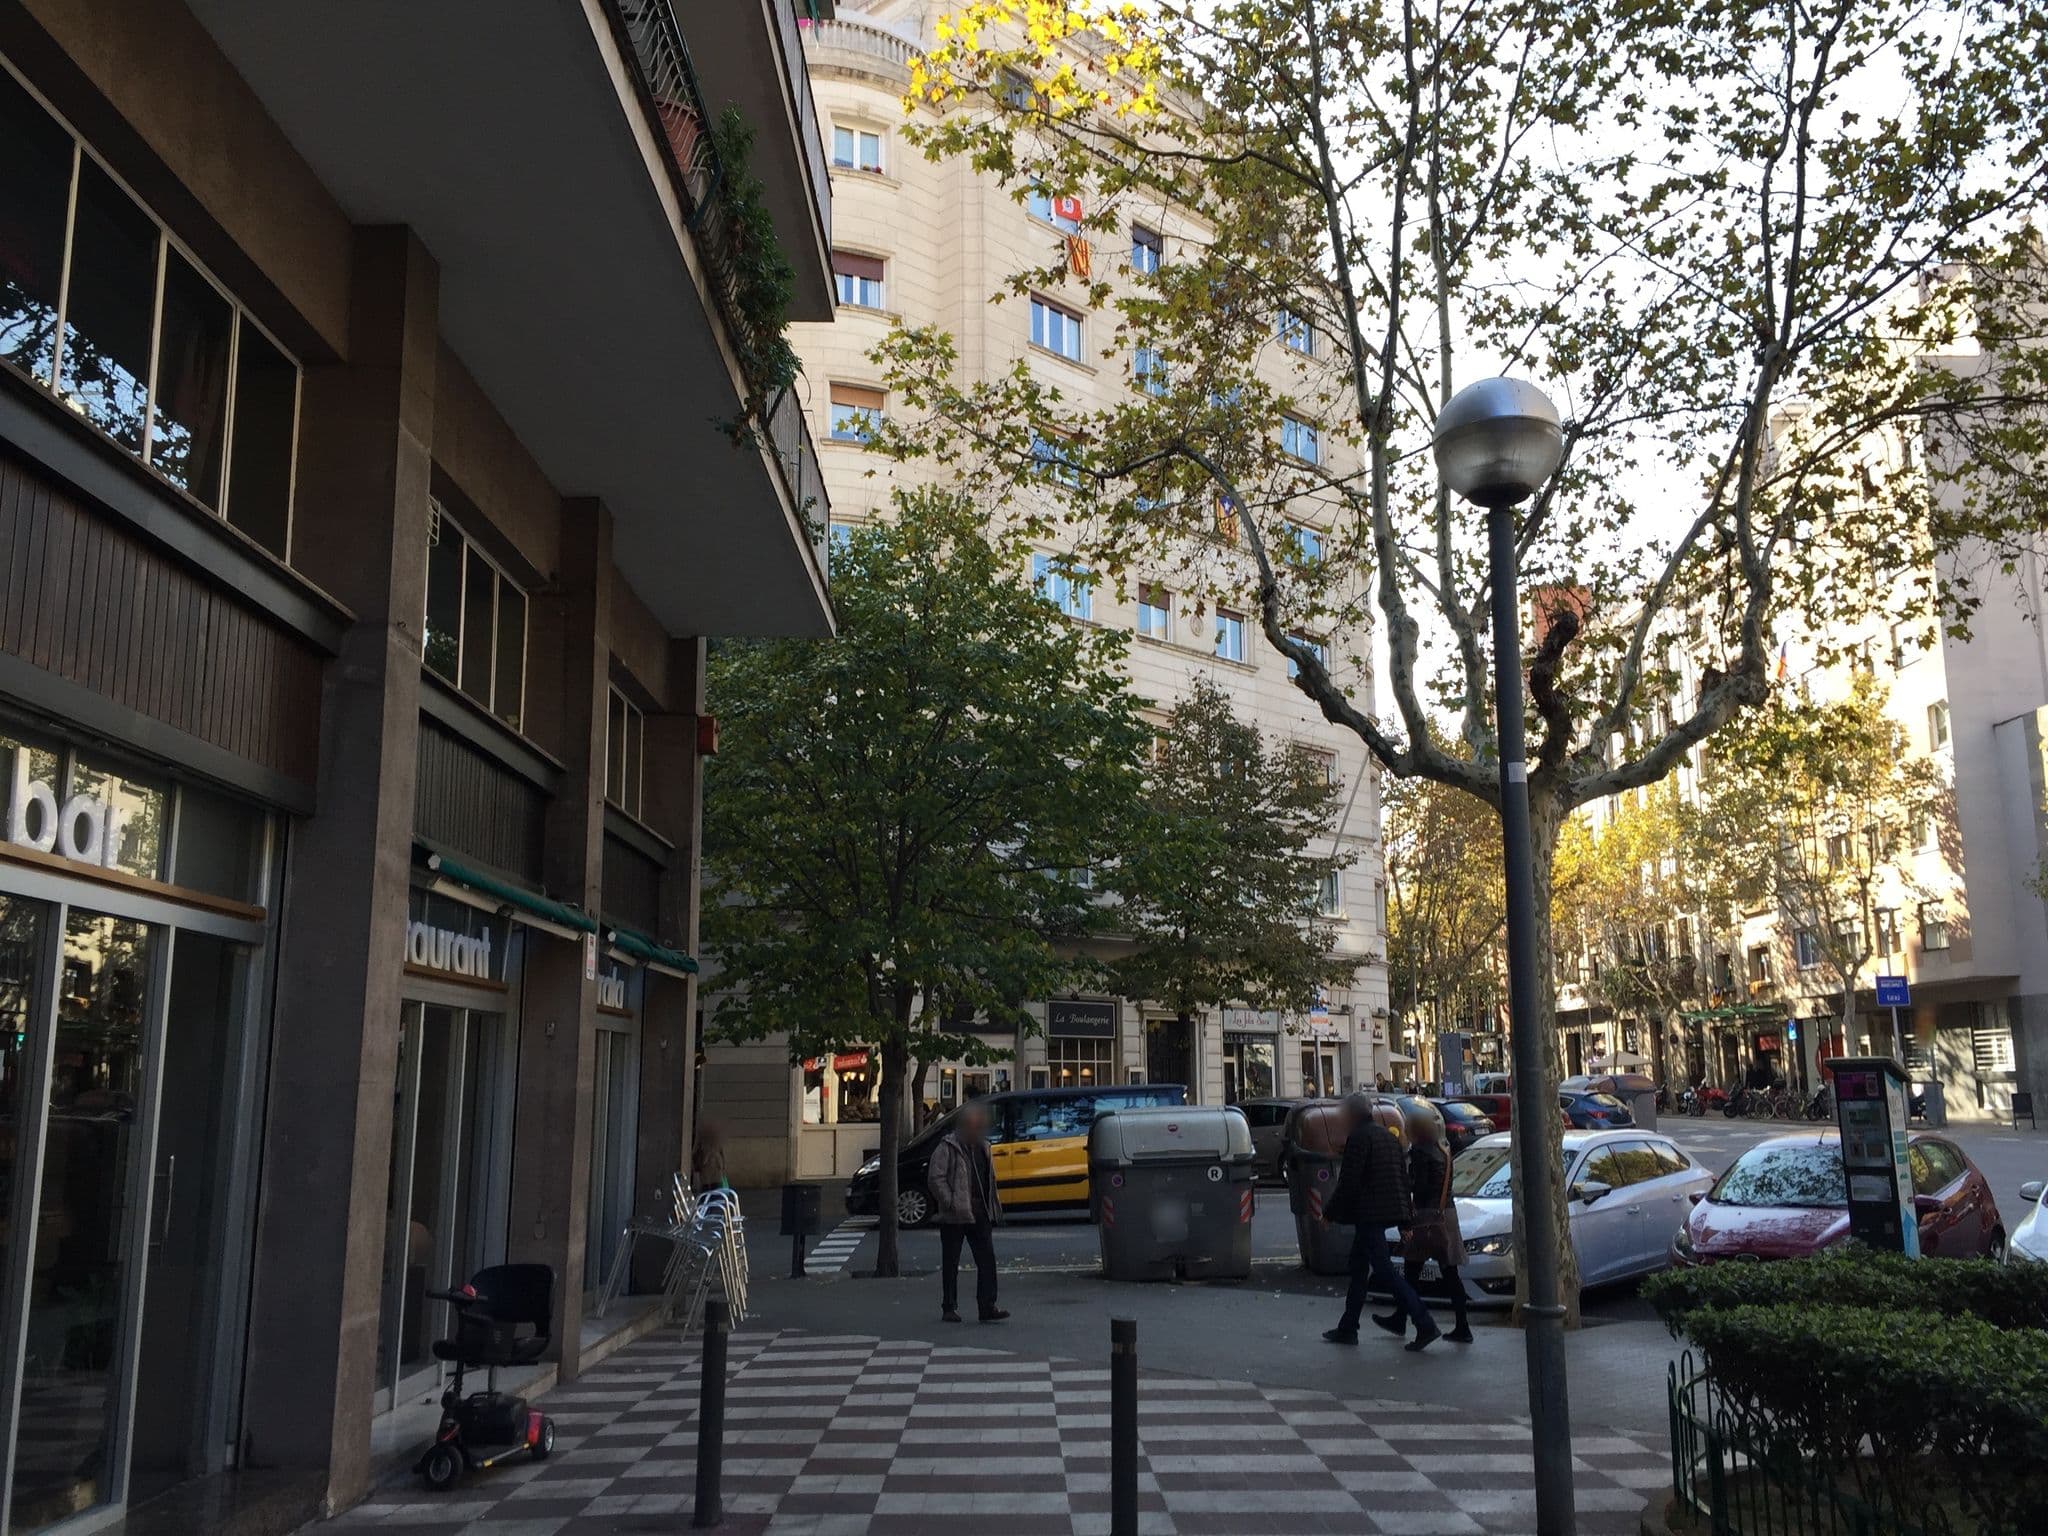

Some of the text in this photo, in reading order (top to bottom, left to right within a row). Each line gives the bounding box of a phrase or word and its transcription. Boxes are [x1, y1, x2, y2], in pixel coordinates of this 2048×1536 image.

[1055, 1012, 1110, 1026] La Boulangerie
[1211, 1169, 1219, 1179] R
